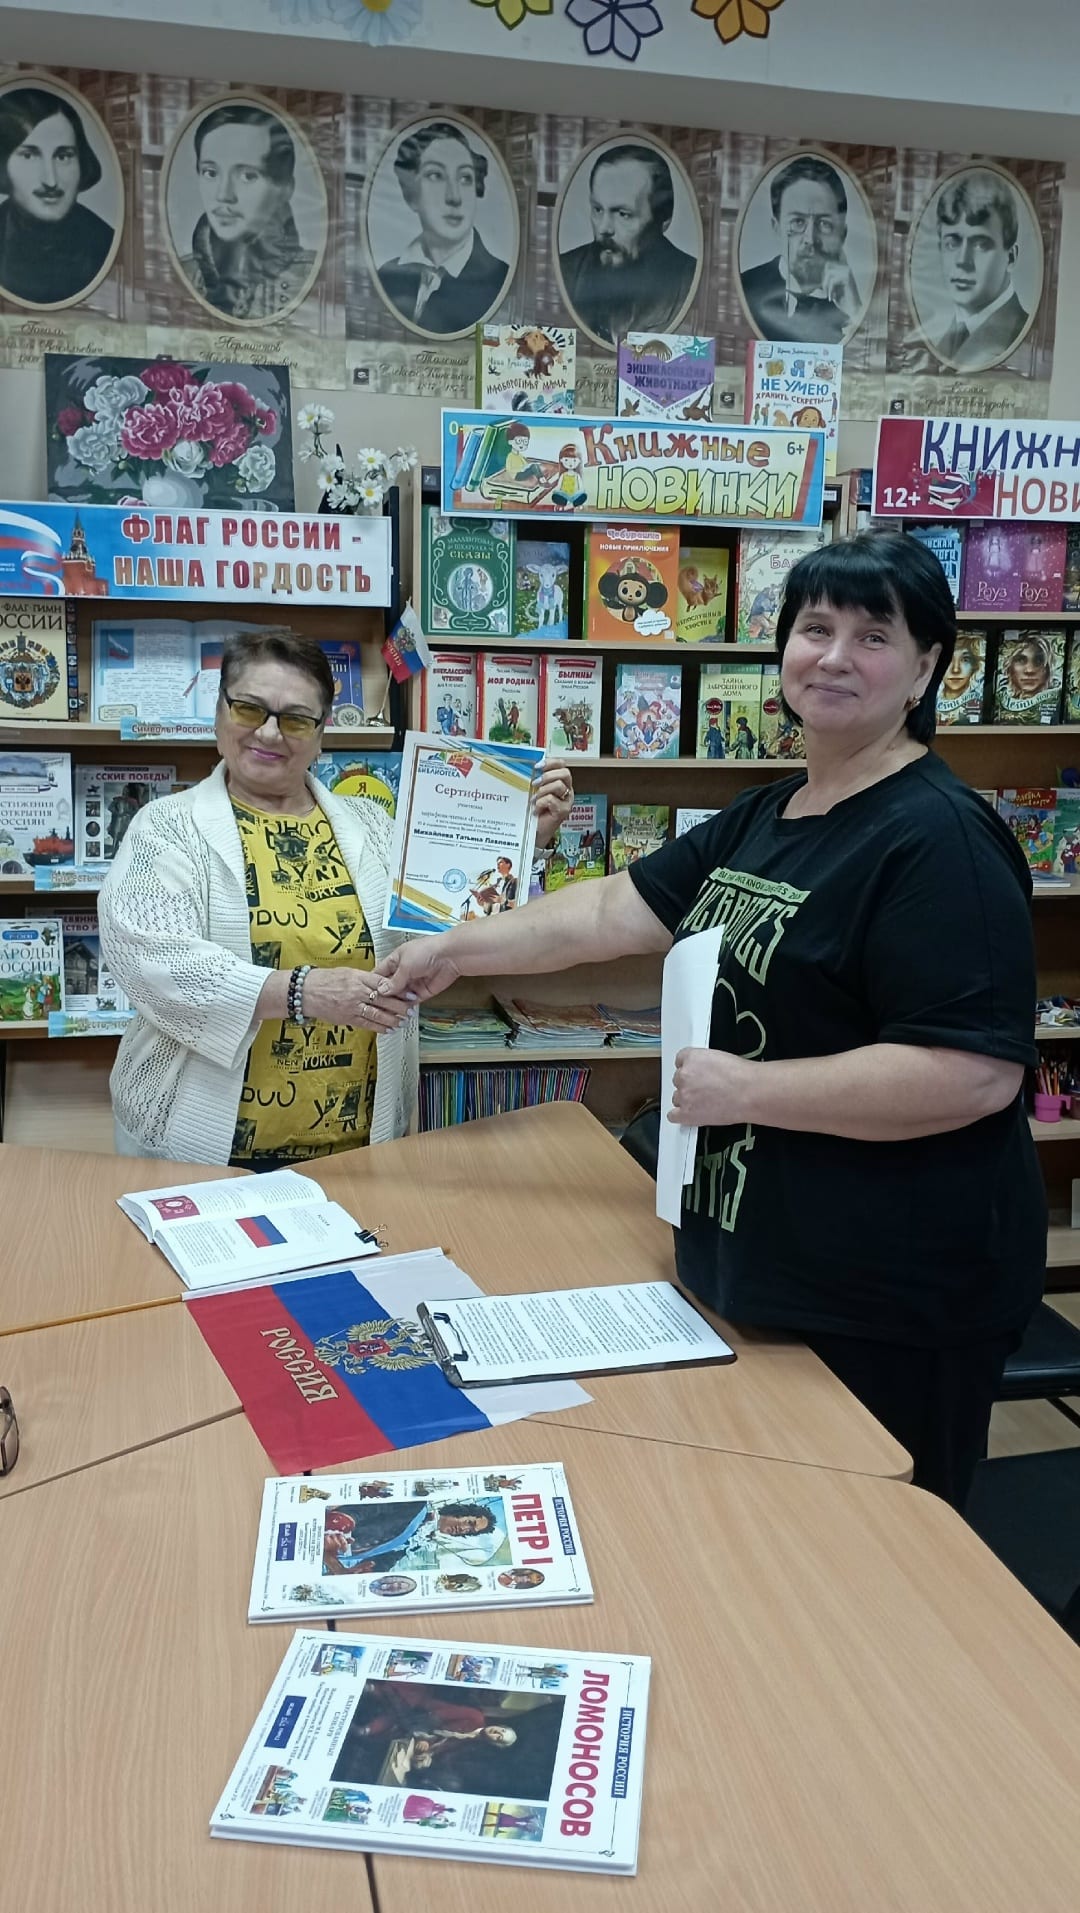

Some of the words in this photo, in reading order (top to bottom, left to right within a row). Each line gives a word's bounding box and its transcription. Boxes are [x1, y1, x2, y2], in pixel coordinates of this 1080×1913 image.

[790, 359, 806, 378] Я
[761, 380, 781, 392] НЕ
[783, 380, 830, 397] УМЕЮ
[578, 422, 772, 468] Книжные
[787, 440, 806, 457] 6+
[597, 465, 800, 519] НОВИНКИ
[883, 487, 922, 508] 12+
[120, 513, 210, 546] ФЛАГ
[221, 517, 342, 551] РОССИИ
[449, 551, 492, 560] СКАЗЫ
[600, 543, 621, 552] НОВЫЕ
[622, 544, 670, 553] ПРИКЛЮЧЕНИЯ
[113, 555, 206, 588] НАША
[215, 559, 372, 595] ГОРДОСТЬ
[977, 580, 1008, 602] Роуз
[1019, 581, 1050, 602] Роуз
[505, 678, 536, 687] РОДИНА
[558, 670, 593, 679] БЫЛИНЫ
[95, 772, 126, 782] ССКИЕ
[128, 772, 170, 783] ПОБЕДЫ
[417, 766, 461, 778] БИБЛИОТЕКА
[356, 781, 367, 793] Я
[434, 783, 511, 803] Сертификат
[259, 1326, 338, 1405] РОССИЯ
[510, 1493, 549, 1551] ПЕТР
[554, 1497, 570, 1528] ИСТОРИЯ
[560, 1527, 576, 1555] РОССИИ
[618, 1709, 635, 1751] ИСТОРИЯ
[559, 1669, 611, 1838] ЛОМОНОСОВ
[612, 1751, 629, 1797] РОССИИ
